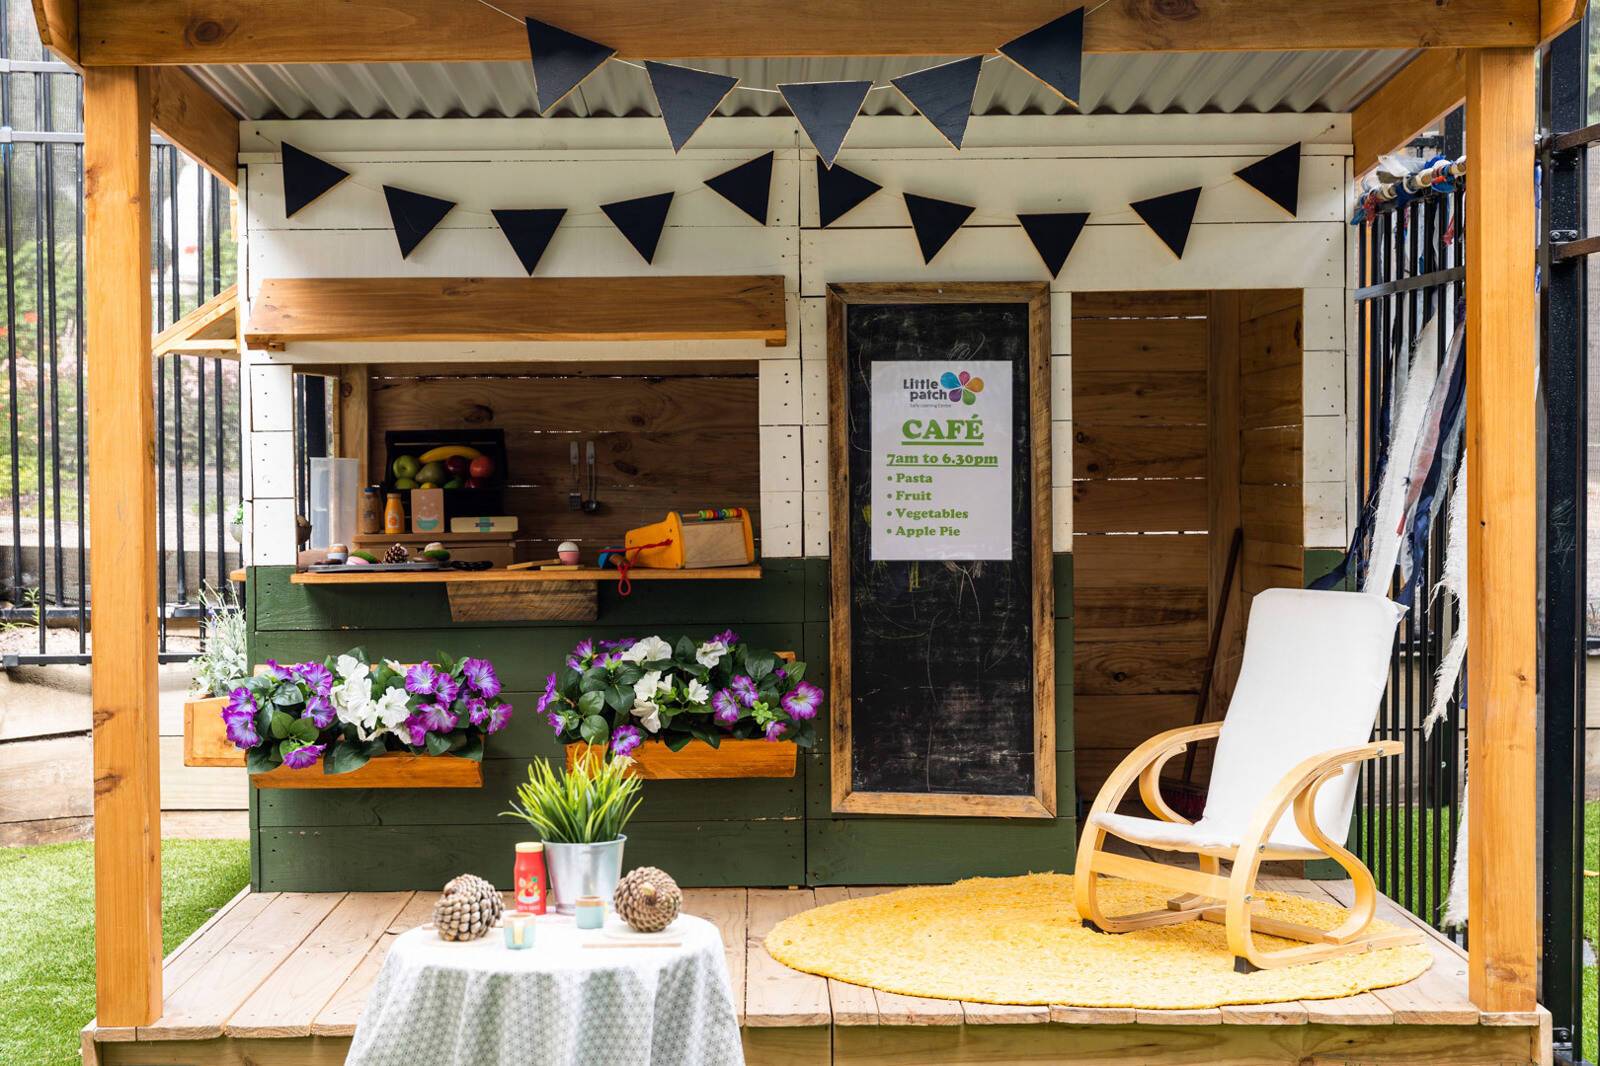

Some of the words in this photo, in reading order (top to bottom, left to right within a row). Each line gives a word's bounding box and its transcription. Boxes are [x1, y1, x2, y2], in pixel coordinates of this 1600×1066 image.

[903, 378, 939, 389] Little
[910, 389, 948, 401] patch
[902, 414, 984, 439] CAFÉ
[887, 453, 918, 464] 7am
[923, 453, 938, 464] to
[942, 453, 998, 465] 6.30pm
[895, 473, 933, 483] Pasta
[895, 490, 932, 501] Fruit
[895, 508, 969, 520] Vegetables
[895, 525, 936, 537] Apple
[940, 525, 961, 536] Pie
